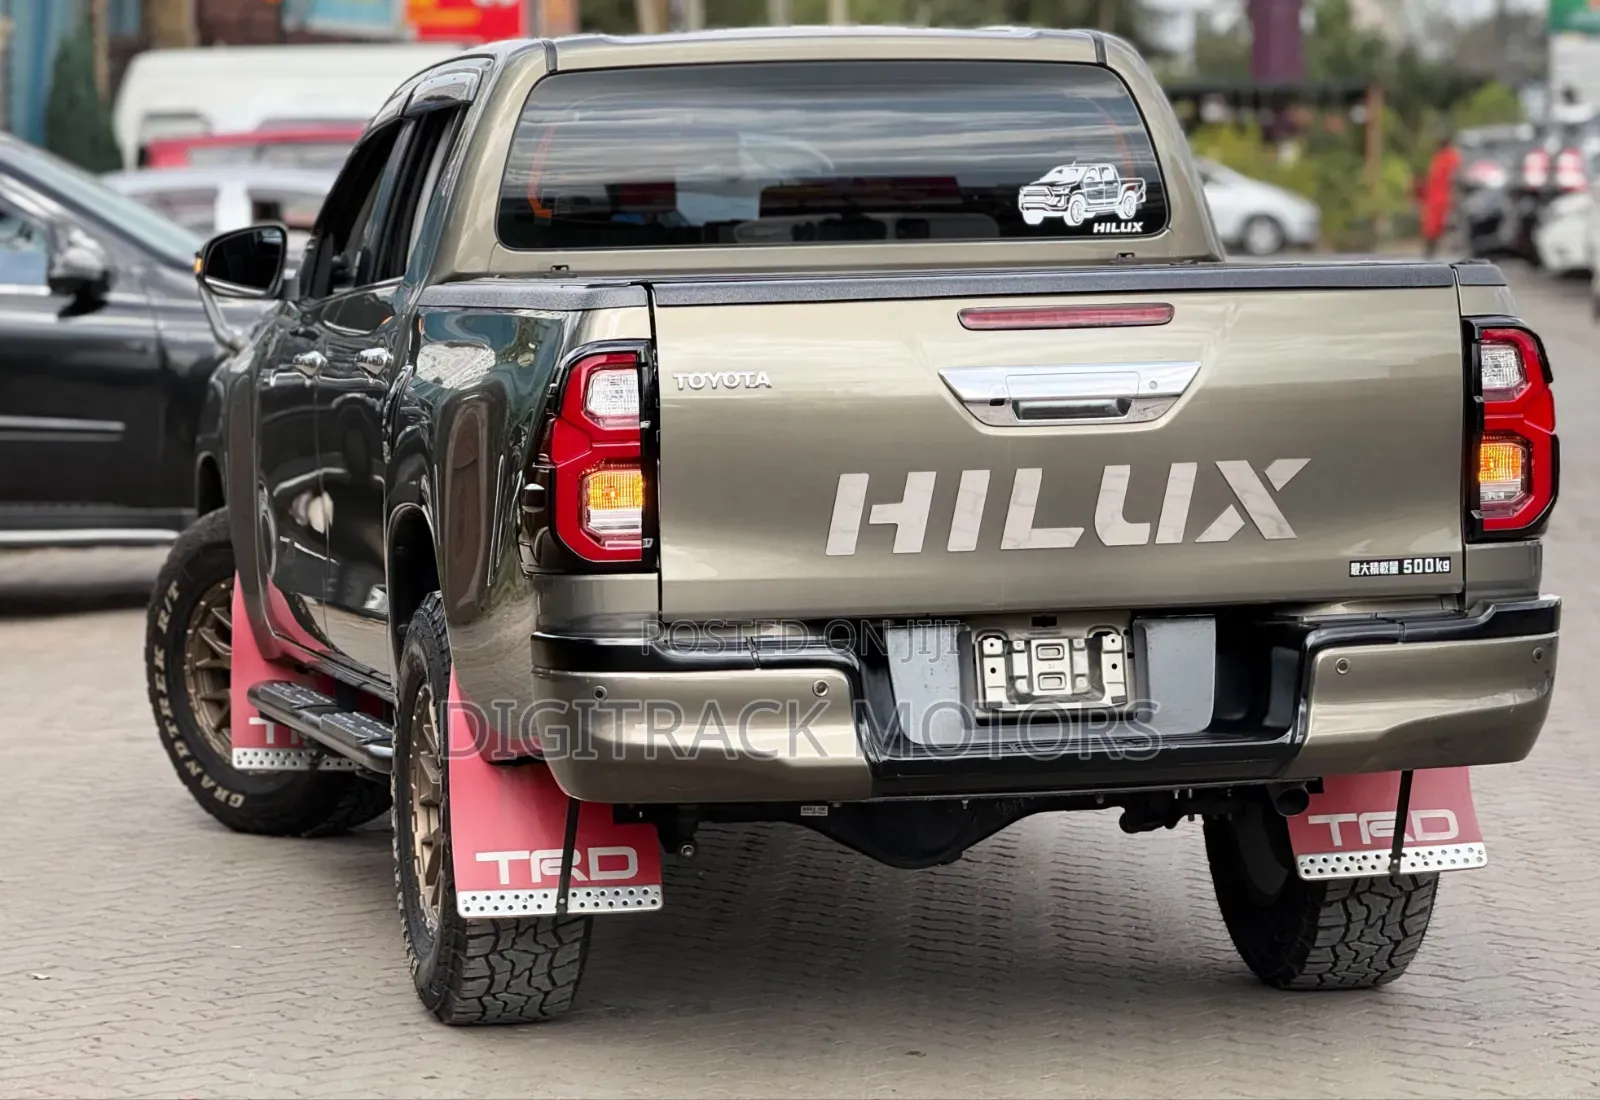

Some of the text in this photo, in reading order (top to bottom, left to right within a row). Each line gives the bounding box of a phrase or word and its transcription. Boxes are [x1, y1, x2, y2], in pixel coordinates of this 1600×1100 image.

[1093, 221, 1144, 234] HILUX
[672, 370, 772, 391] TOYOTA
[825, 458, 1312, 556] HILUX
[1403, 557, 1450, 574] 500kg
[154, 579, 246, 808] GRANDTREK R/T
[475, 846, 638, 885] TRD
